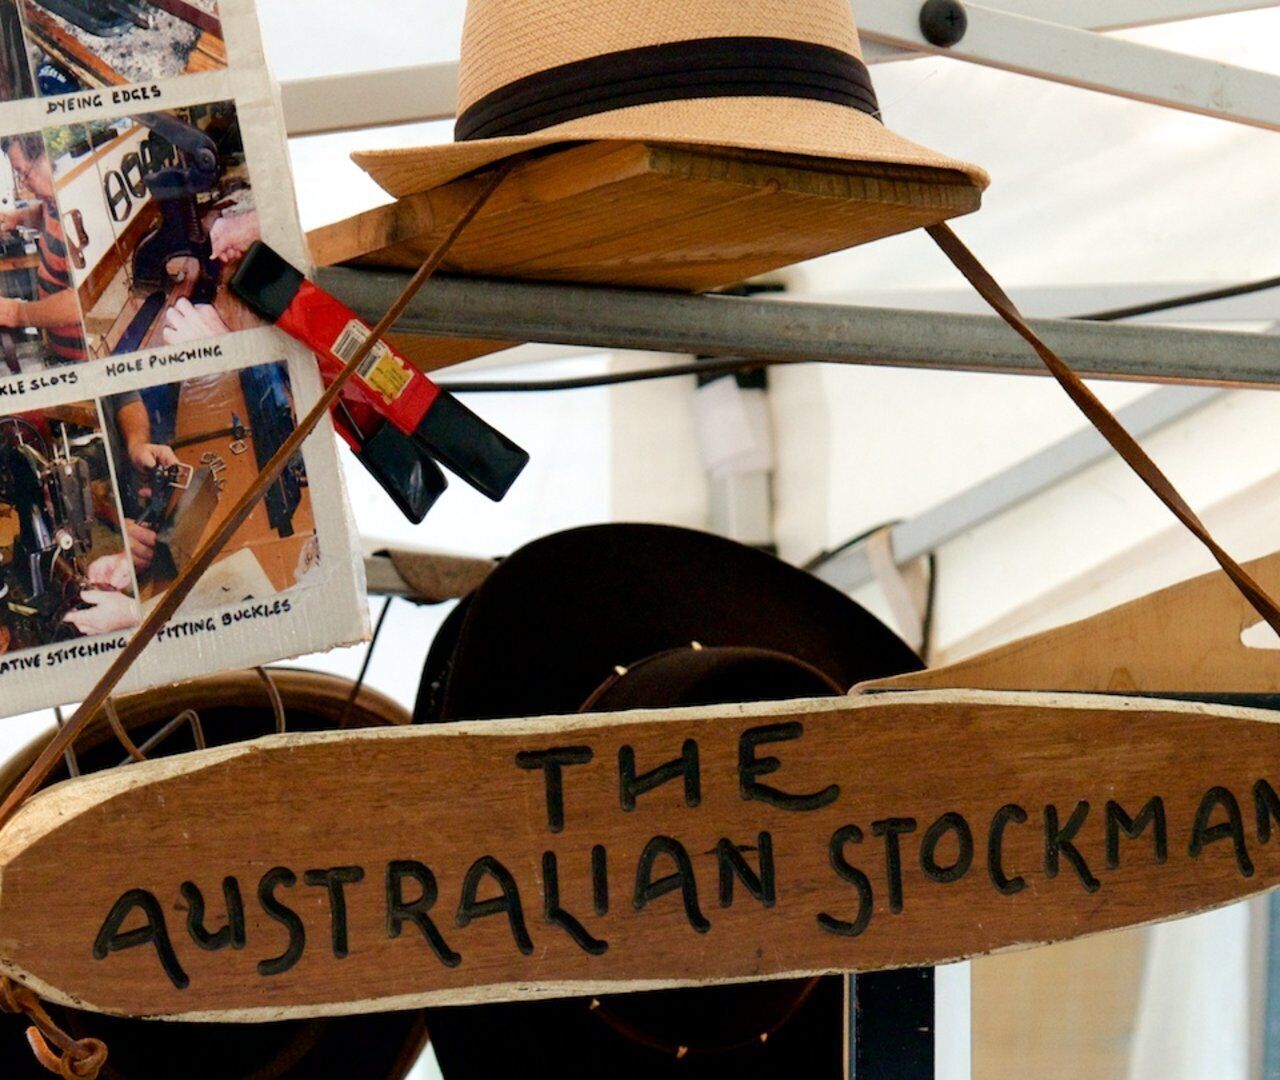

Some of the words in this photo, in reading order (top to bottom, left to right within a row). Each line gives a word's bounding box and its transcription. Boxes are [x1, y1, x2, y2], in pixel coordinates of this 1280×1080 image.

[46, 94, 102, 115] DYEING
[112, 84, 162, 105] EDGES
[106, 359, 143, 377] HOLE
[150, 345, 223, 368] PUNCHING
[30, 371, 79, 392] SLOTS
[221, 598, 292, 626] BUCKLES
[46, 636, 128, 666] STITCHING
[515, 721, 841, 834] THE
[93, 830, 776, 990] AUSTRALIAN
